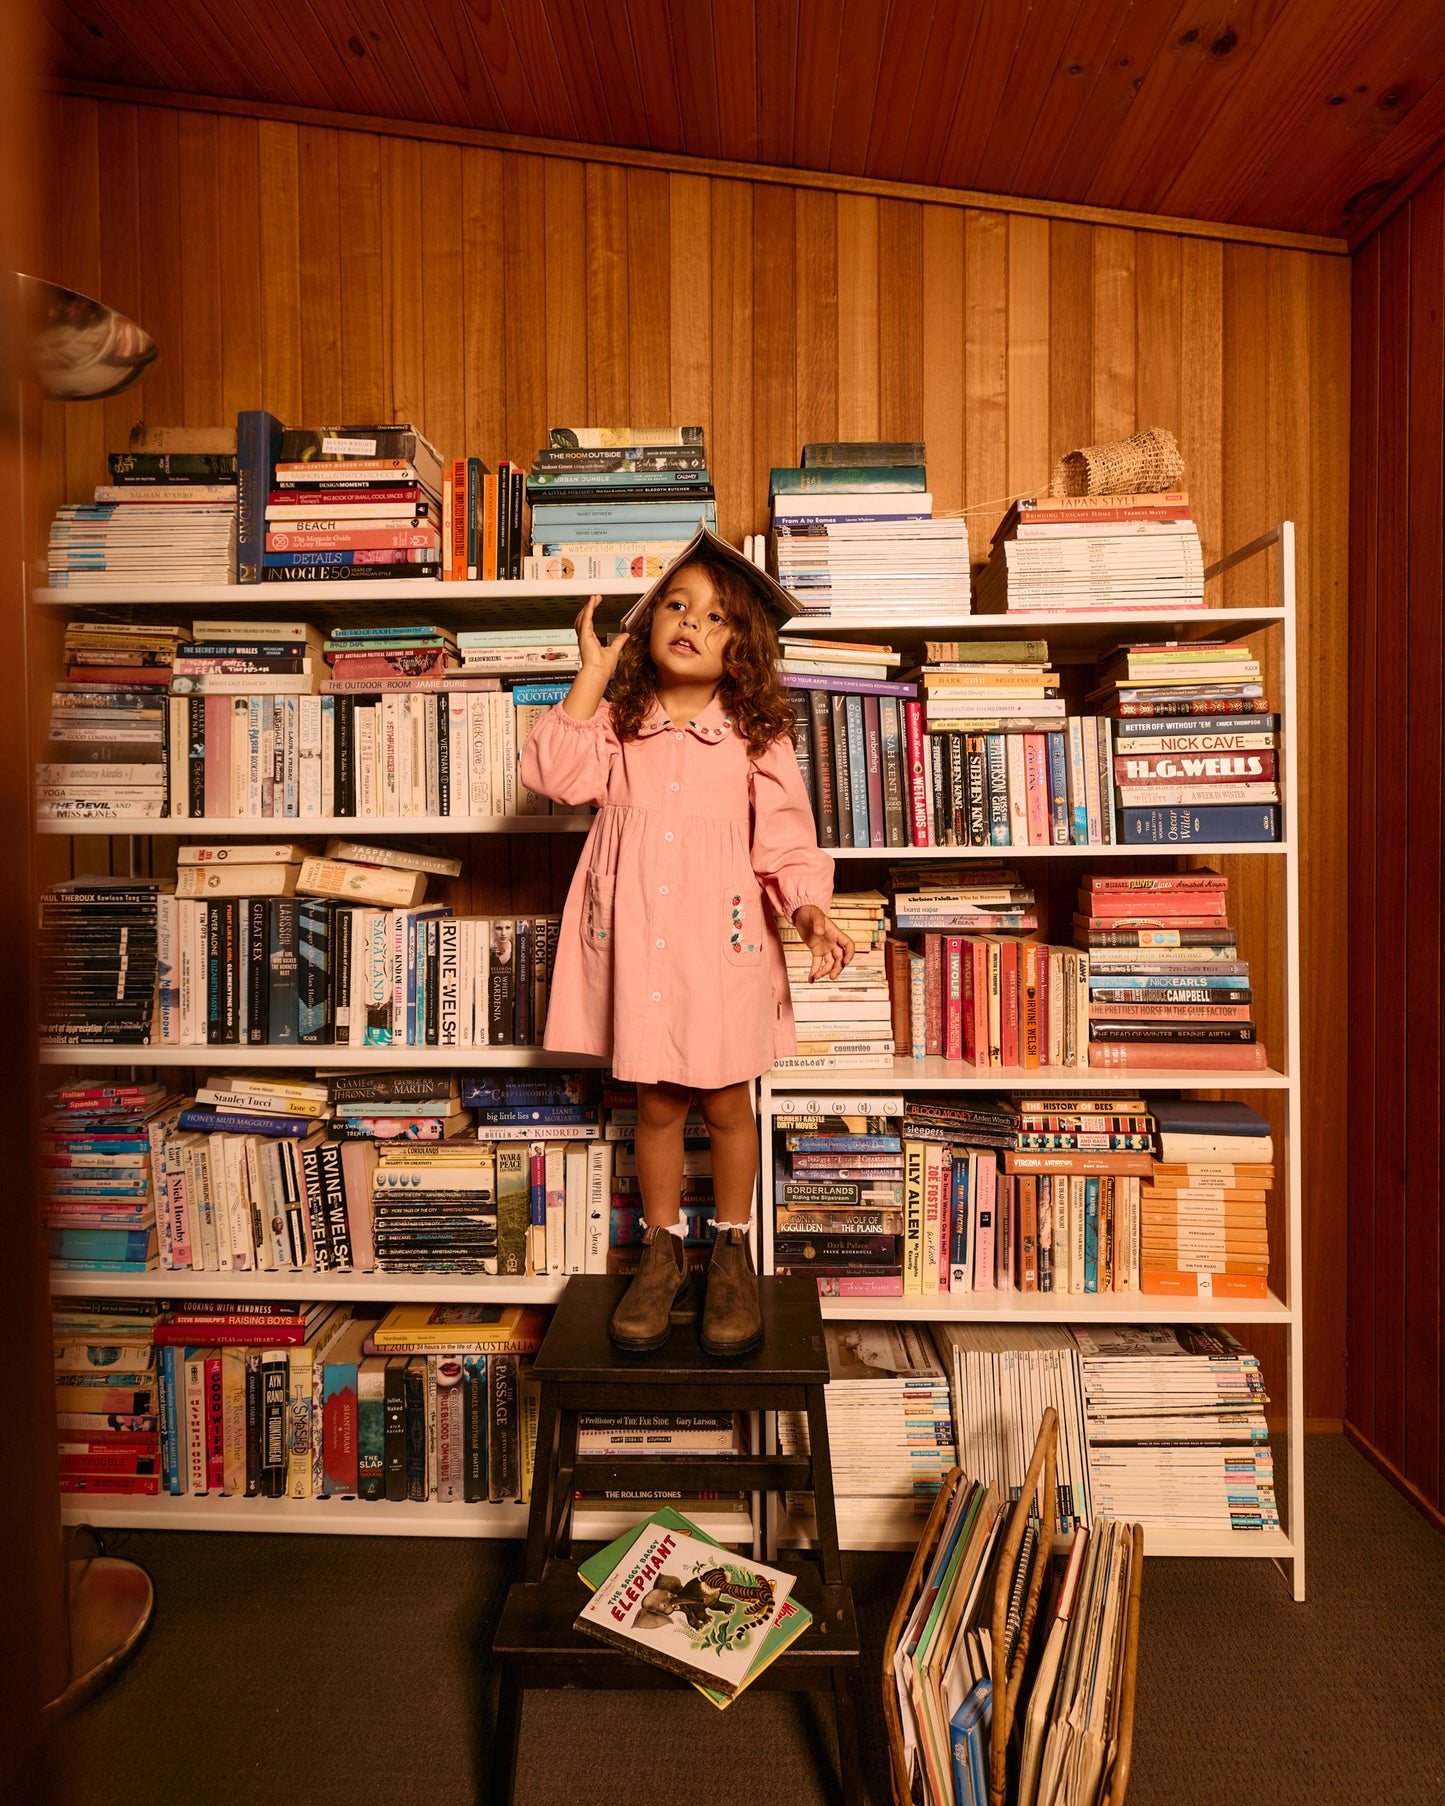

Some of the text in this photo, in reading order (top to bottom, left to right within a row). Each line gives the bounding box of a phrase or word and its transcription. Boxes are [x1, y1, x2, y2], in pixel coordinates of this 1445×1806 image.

[1061, 497, 1137, 508] JAPAN STYLE
[297, 522, 335, 530] BEACH
[619, 544, 646, 552] living
[293, 553, 342, 564] DETAILS
[269, 567, 350, 579] IN VOGUE 50
[885, 708, 894, 758] HANNAH
[1161, 736, 1245, 750] NICK CAVE
[819, 726, 832, 814] ALMOST CHIMPANZEE
[952, 737, 962, 809] STEPHEN KING
[990, 745, 1006, 792] PATTERSON
[913, 777, 926, 827] WETLANDS
[970, 757, 983, 832] STEPHEN KING
[992, 796, 1001, 822] GIRLS
[1168, 810, 1178, 840] Oscar
[1181, 810, 1191, 839] Wilde
[351, 846, 392, 858] JASPER
[354, 853, 388, 864] JONES
[253, 904, 262, 960] GREAT SEX
[279, 904, 292, 944] LARSSON
[536, 925, 545, 964] BLOCK
[373, 920, 384, 1000] SAGA LAND
[396, 976, 402, 985] OF
[443, 921, 456, 1045] IRVINE WELSH
[1168, 990, 1210, 1002] CAMPBELL
[1106, 1006, 1138, 1014] PRETTIEST
[1140, 1006, 1162, 1014] HORSE
[1206, 1008, 1237, 1016] FACTORY
[1027, 1000, 1036, 1055] IRVINE WELSH
[336, 1079, 366, 1088] GAME
[394, 1085, 433, 1094] MARTIN
[70, 1100, 98, 1108] Spanish
[213, 1093, 272, 1107] Stanley Tucci
[333, 1090, 375, 1099] THRONES
[237, 1118, 273, 1127] MAGGOTS
[487, 1111, 529, 1121] big little lies
[911, 1106, 973, 1121] BLOOD MONEY
[534, 1128, 579, 1137] KINDRED
[907, 1125, 944, 1136] sleepers
[500, 1160, 521, 1168] PEACE
[592, 1152, 602, 1204] NAOMI CAMPBELL
[321, 1144, 349, 1269] IRVINE WELSH
[908, 1154, 920, 1239] LILY ALLEN
[303, 1148, 329, 1272] IRVINE WELSH
[174, 1206, 184, 1243] Hornby
[183, 1303, 214, 1311] COOKING
[237, 1304, 271, 1313] KINDNESS
[496, 1365, 506, 1425] PASSAGE
[624, 1417, 637, 1425] THE
[639, 1417, 651, 1425] FAR
[653, 1417, 669, 1425] SIDE
[676, 1417, 691, 1426] Gary
[694, 1417, 717, 1426] Larson
[269, 1417, 281, 1462] FOUNTAINHEAD
[608, 1540, 659, 1606] THE SAGGY BAGGY
[611, 1534, 677, 1622] ELEPHANT
